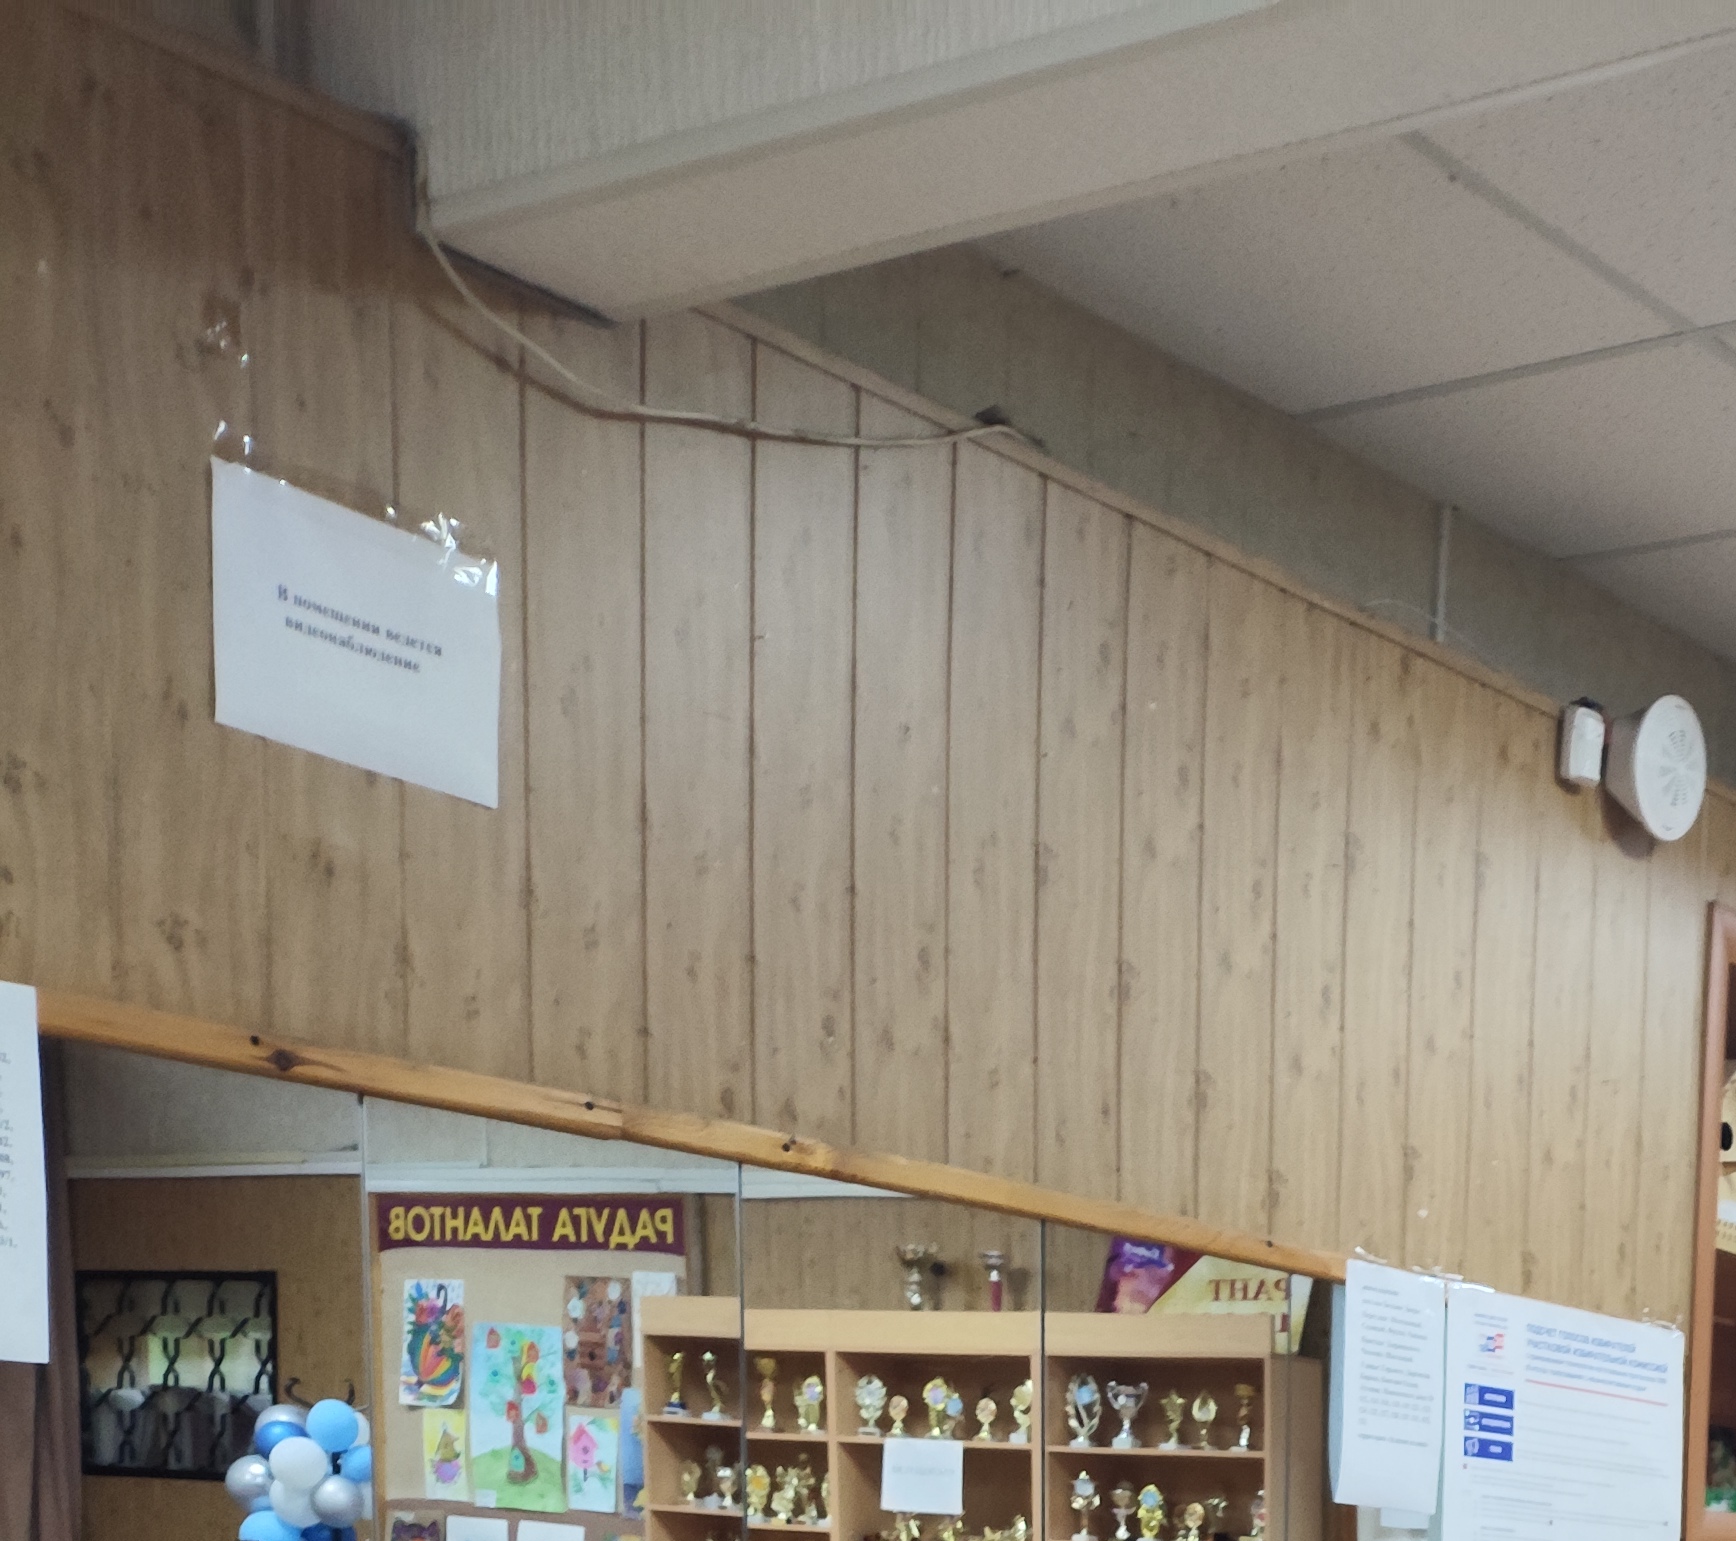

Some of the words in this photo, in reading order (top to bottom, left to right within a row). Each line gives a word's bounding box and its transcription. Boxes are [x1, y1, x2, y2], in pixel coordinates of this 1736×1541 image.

[278, 584, 288, 601] В
[294, 595, 380, 635] помещении
[285, 616, 421, 673] видеонаблюдение
